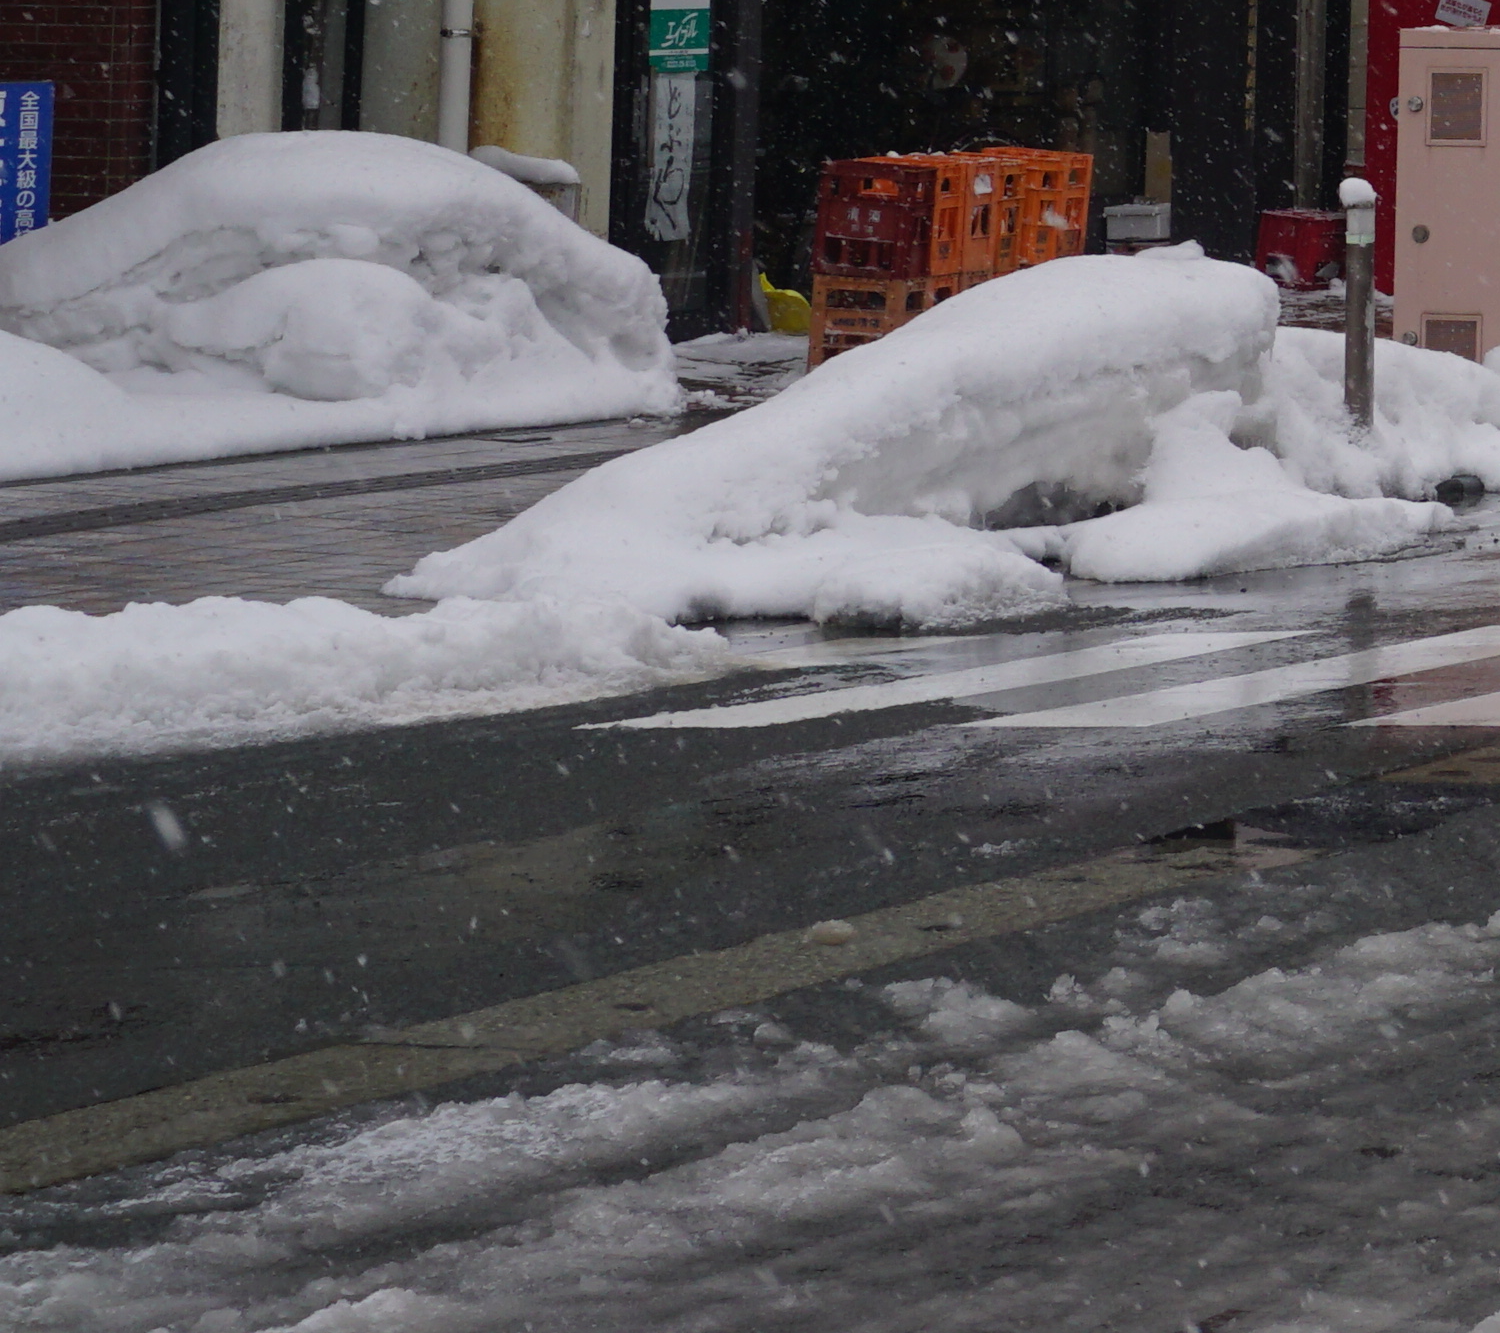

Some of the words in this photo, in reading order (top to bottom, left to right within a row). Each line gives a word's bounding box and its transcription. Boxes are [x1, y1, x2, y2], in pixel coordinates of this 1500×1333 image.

[13, 90, 41, 237] 全国最大級の高
